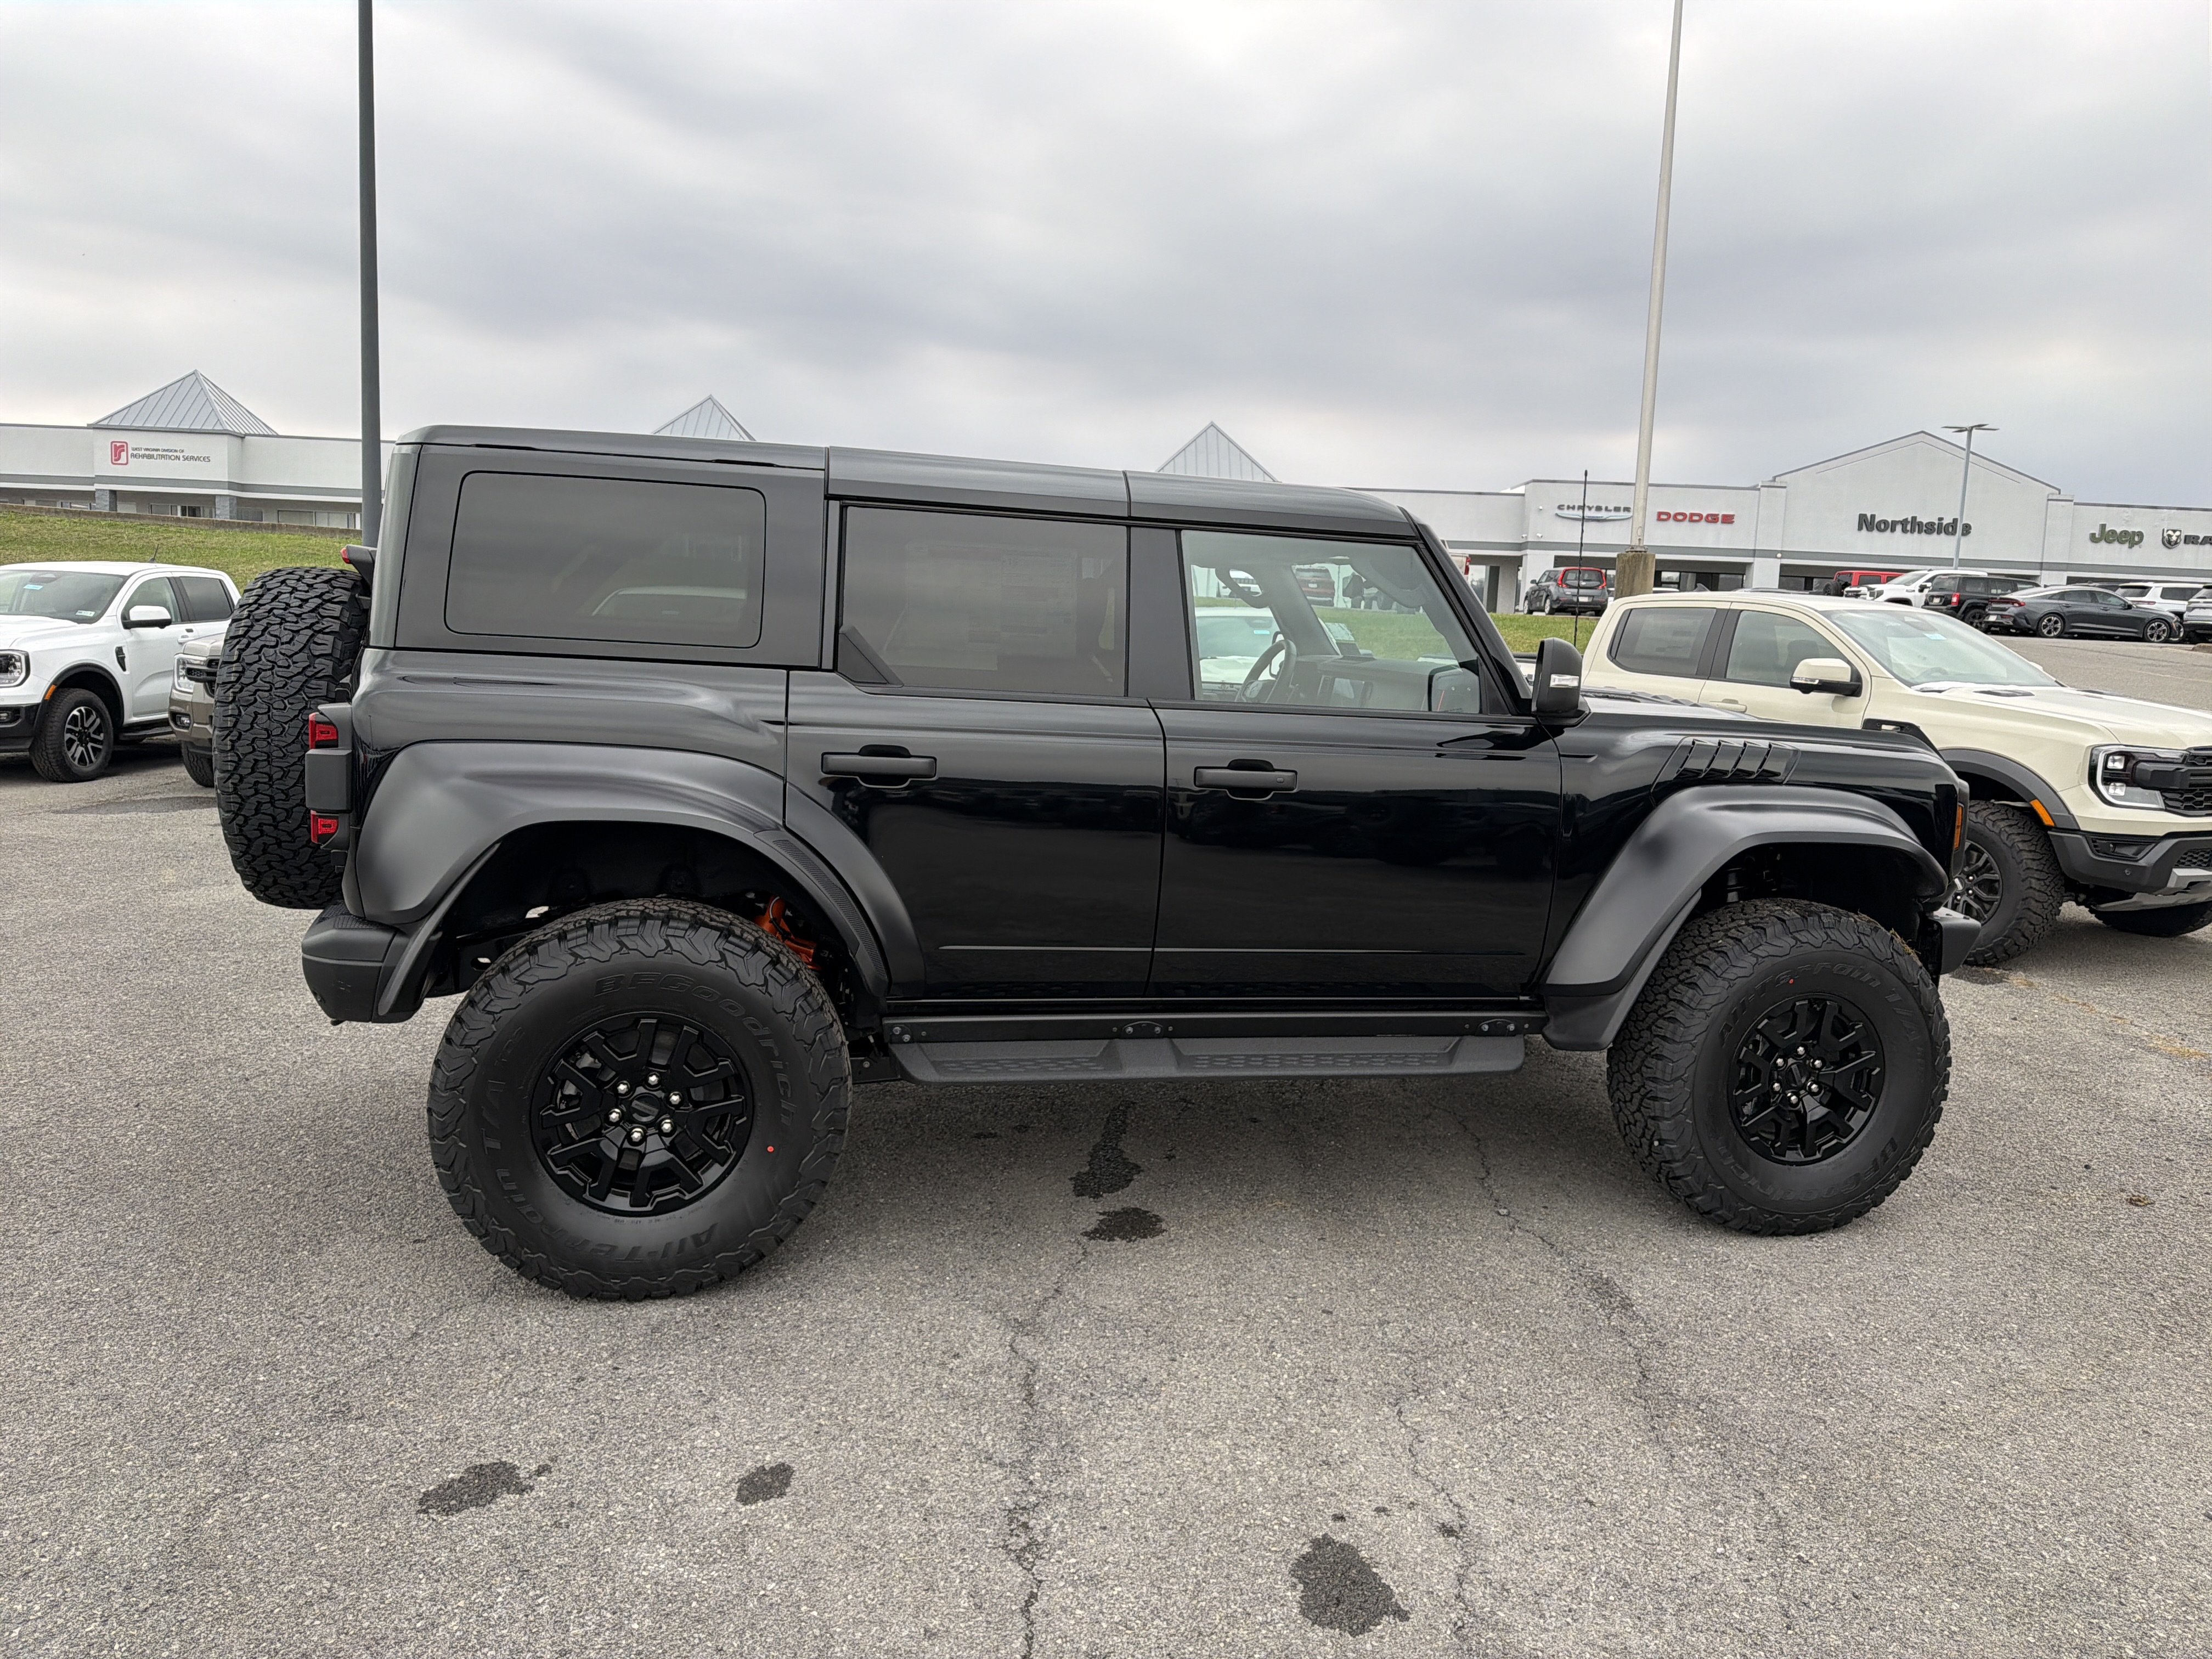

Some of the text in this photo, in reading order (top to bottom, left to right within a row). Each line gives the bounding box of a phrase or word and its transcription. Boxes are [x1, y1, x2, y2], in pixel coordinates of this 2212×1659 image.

[130, 452, 180, 461] REHABILITATION
[1557, 504, 1632, 513] CHRYSLER
[1656, 511, 1735, 524] DODGE
[1857, 513, 1972, 537] Northside
[2089, 523, 2145, 549] Jeep
[1719, 961, 1882, 1049] All-Terrain
[593, 972, 797, 1126] BFGoodrich
[495, 1169, 719, 1262] All-Terrain
